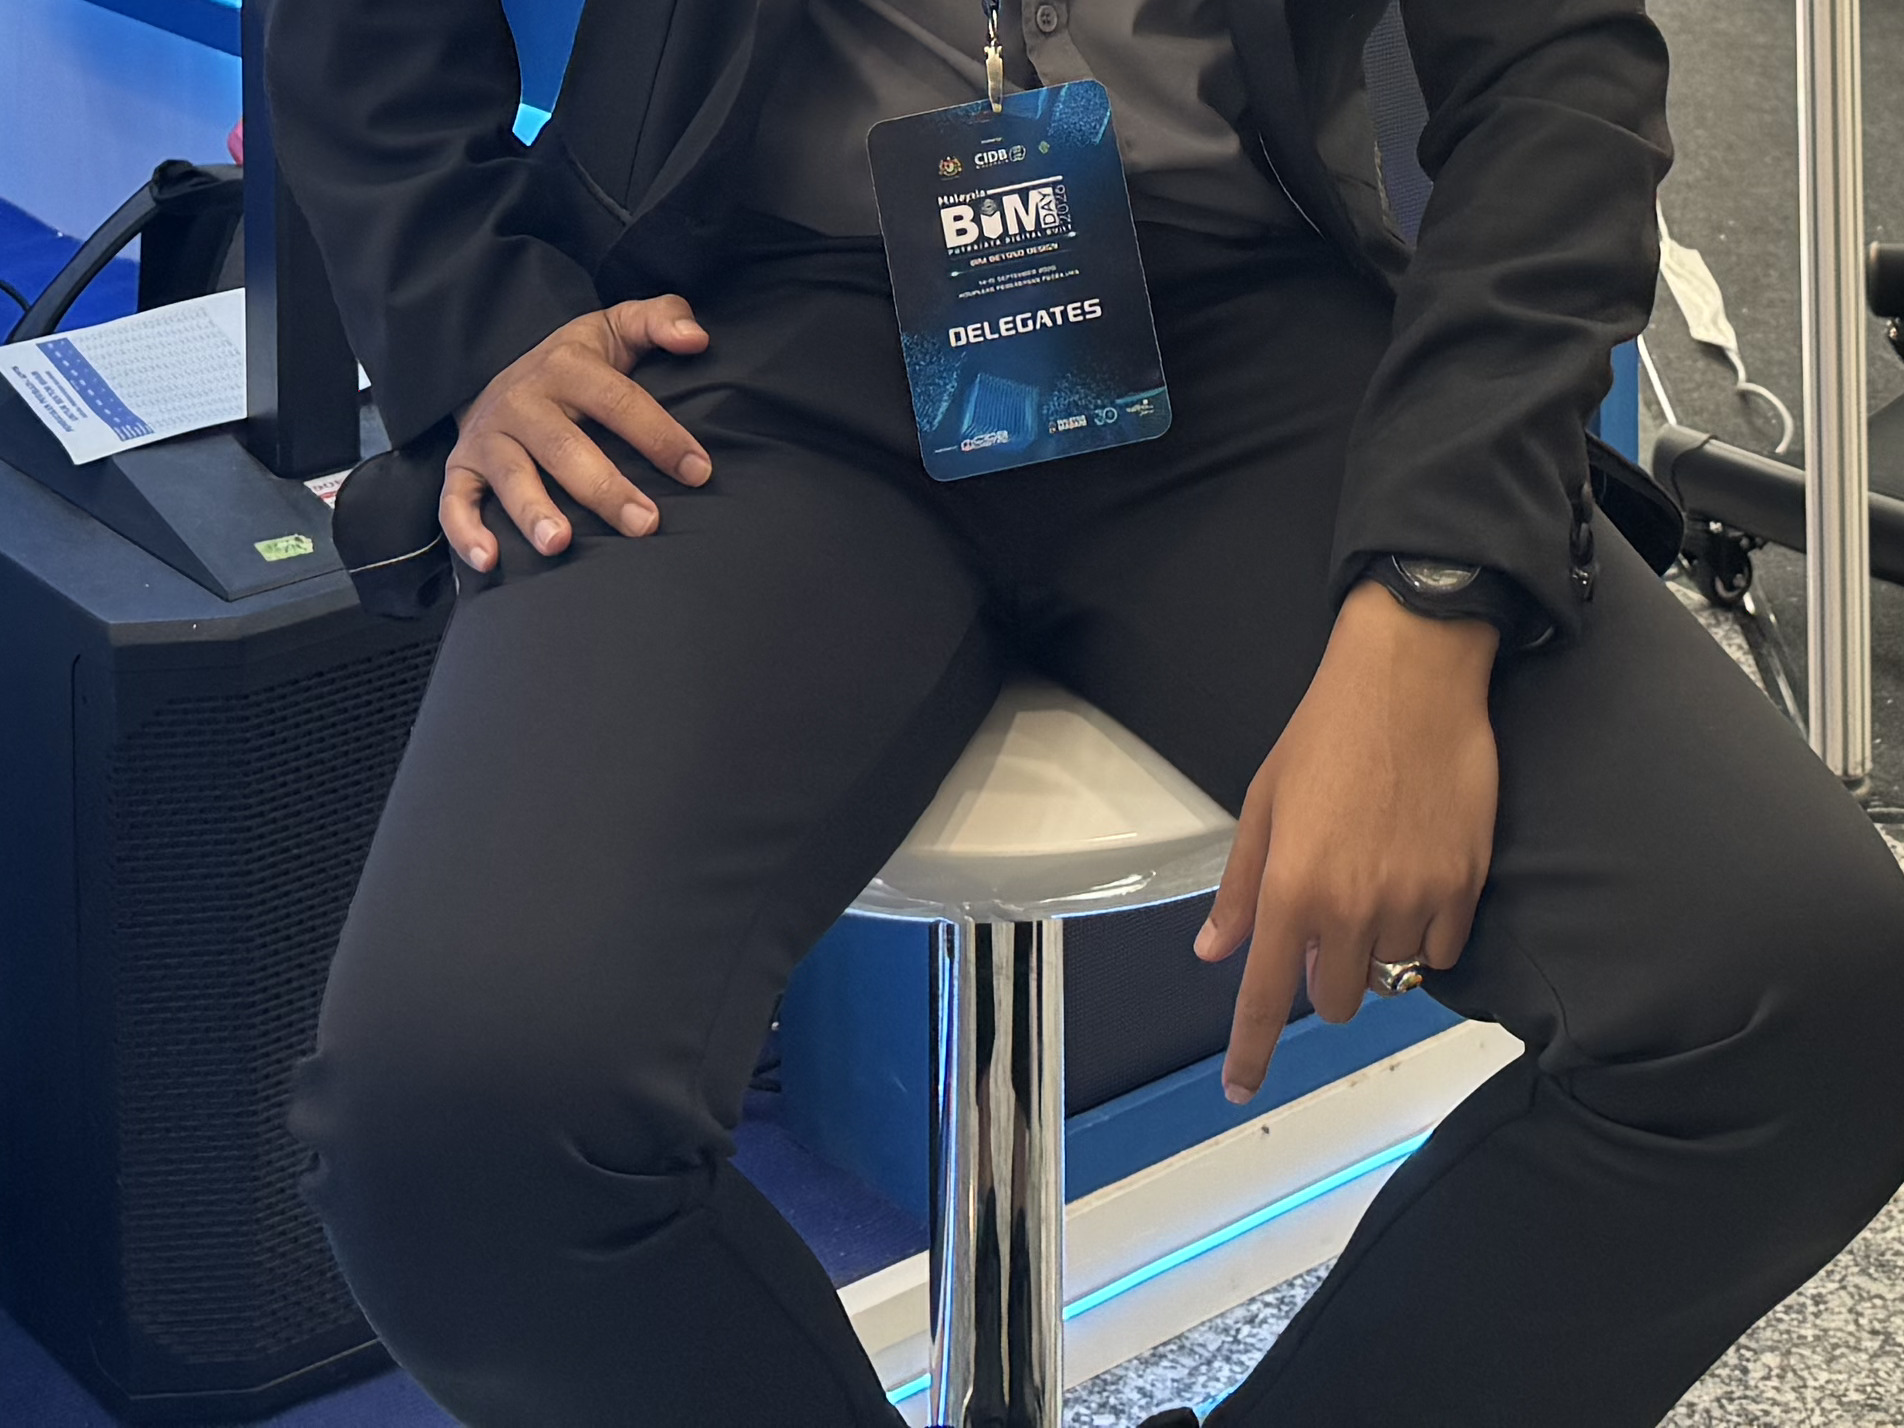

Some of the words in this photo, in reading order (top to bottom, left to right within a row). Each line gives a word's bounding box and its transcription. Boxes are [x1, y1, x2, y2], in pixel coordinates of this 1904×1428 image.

[974, 148, 1008, 165] CIDB
[1037, 190, 1057, 226] DAY
[948, 298, 1103, 348] DELEGATES
